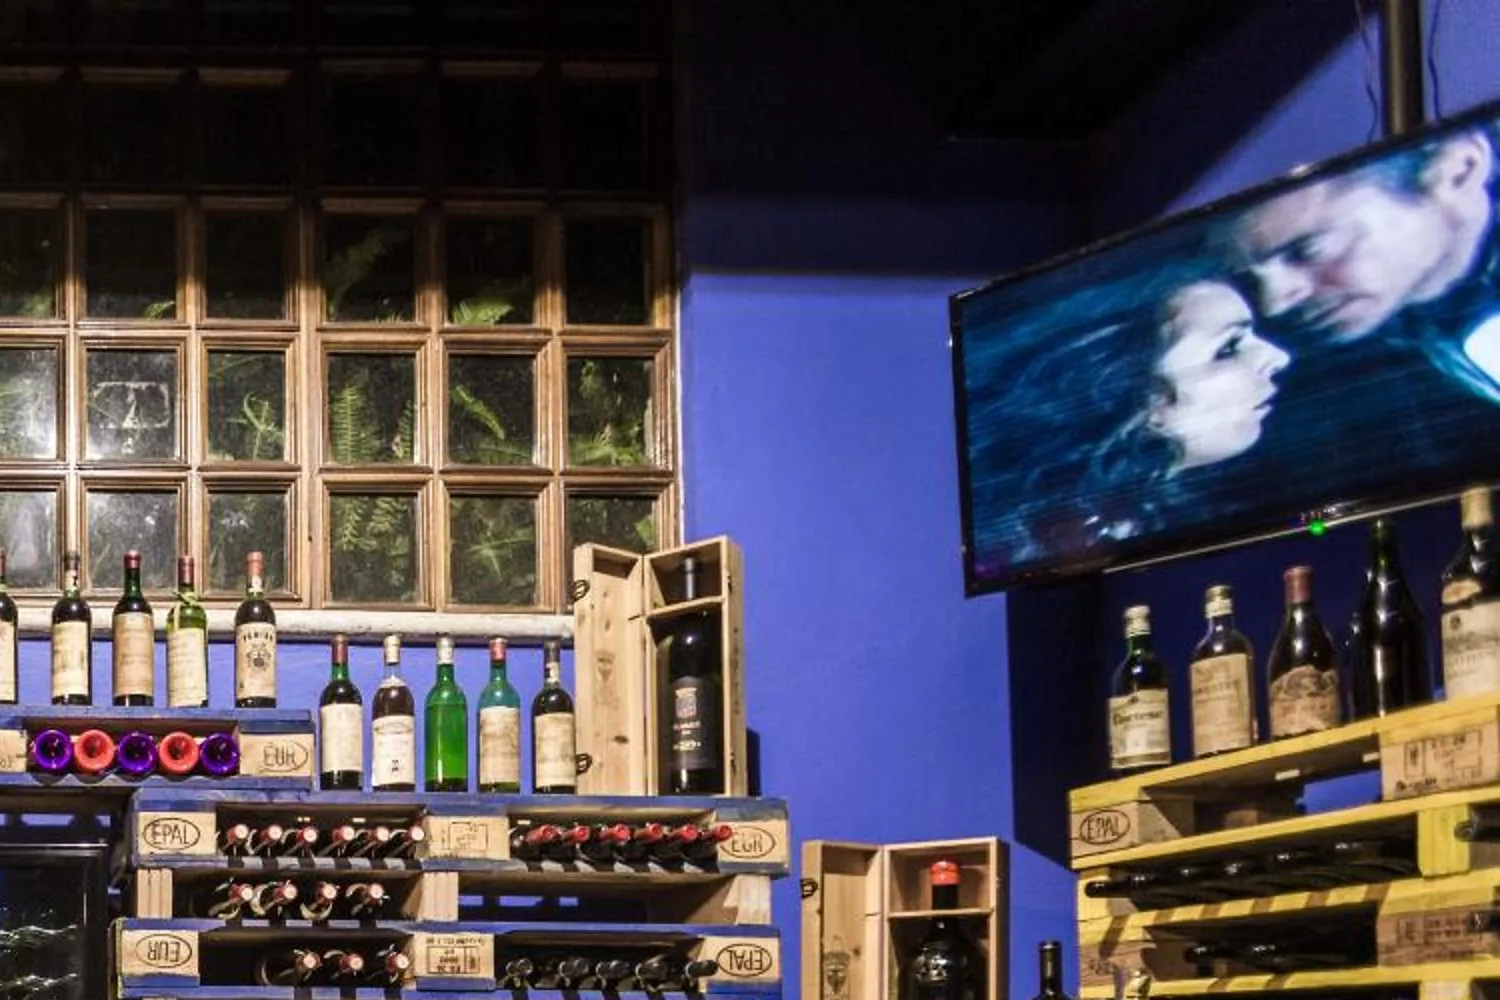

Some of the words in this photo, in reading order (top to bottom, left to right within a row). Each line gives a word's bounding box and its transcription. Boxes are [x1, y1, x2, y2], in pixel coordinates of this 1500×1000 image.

[151, 824, 191, 846] EPAL
[1086, 816, 1121, 841] EPAL
[724, 950, 764, 971] EPAL
